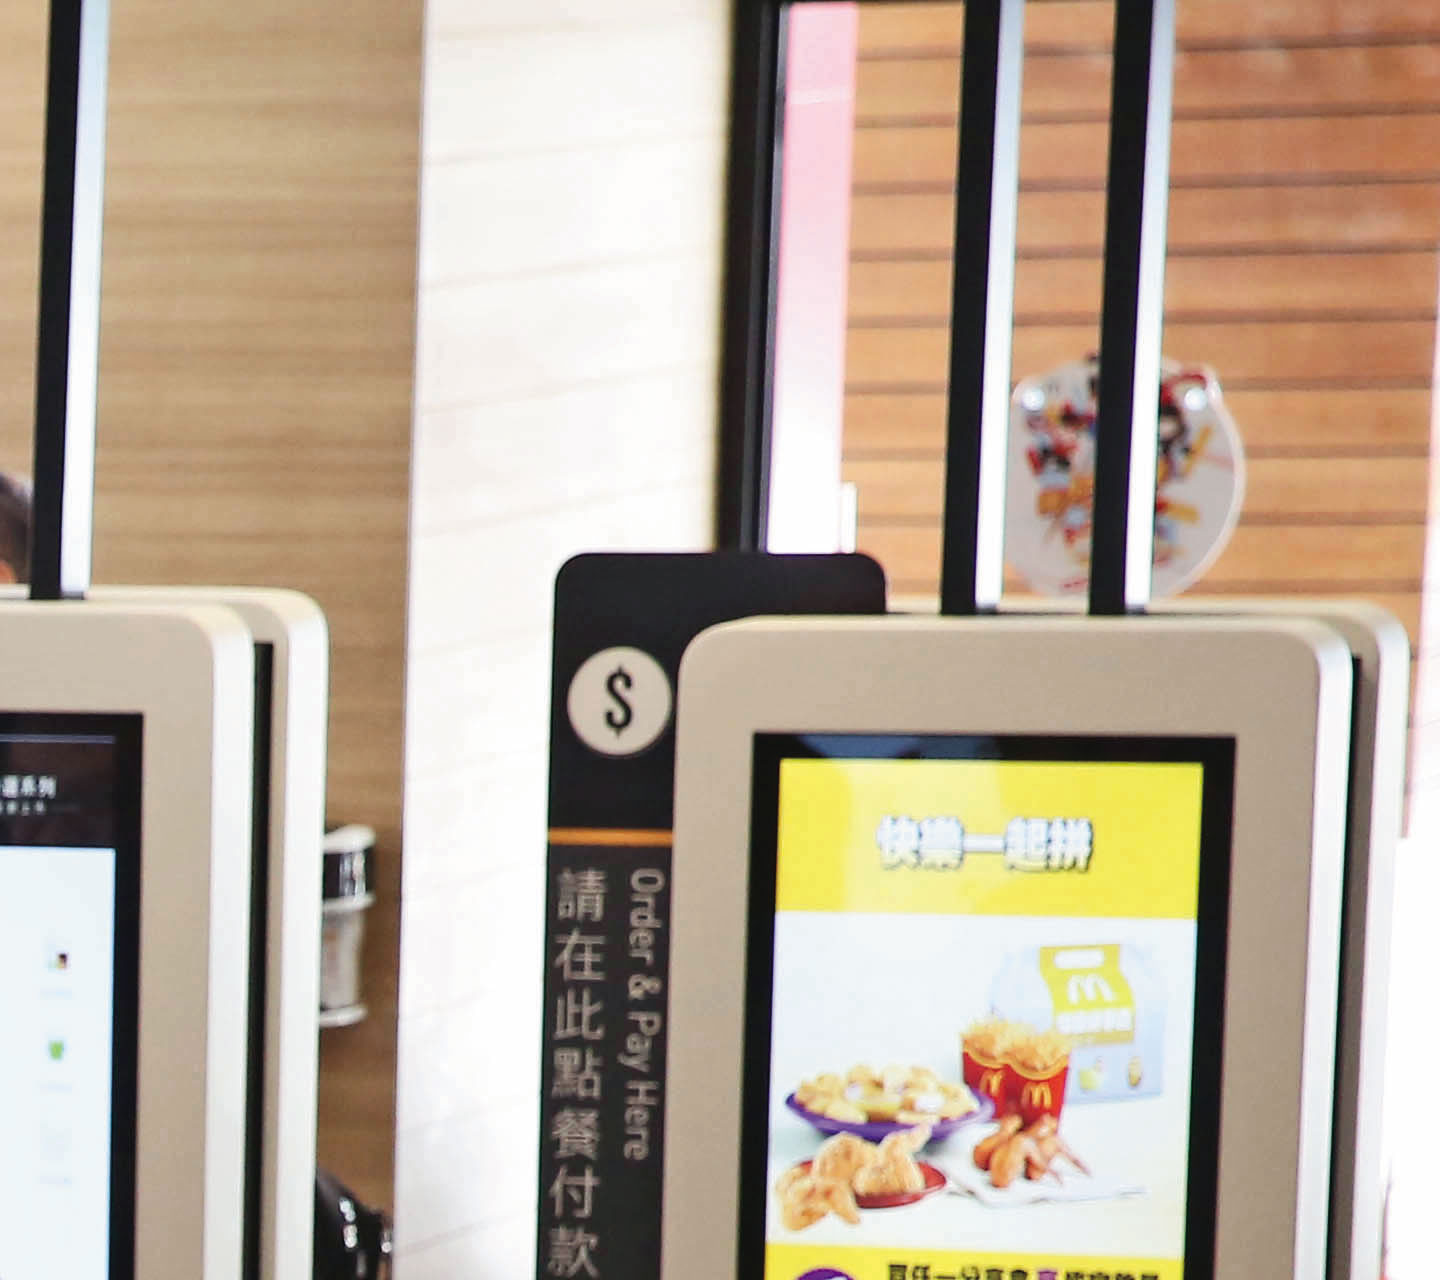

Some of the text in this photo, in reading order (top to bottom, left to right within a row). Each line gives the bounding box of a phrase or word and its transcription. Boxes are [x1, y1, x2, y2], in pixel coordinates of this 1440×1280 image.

[547, 867, 608, 1279] 請在此點餐付款
[617, 867, 665, 1161] Order & Pay Here
